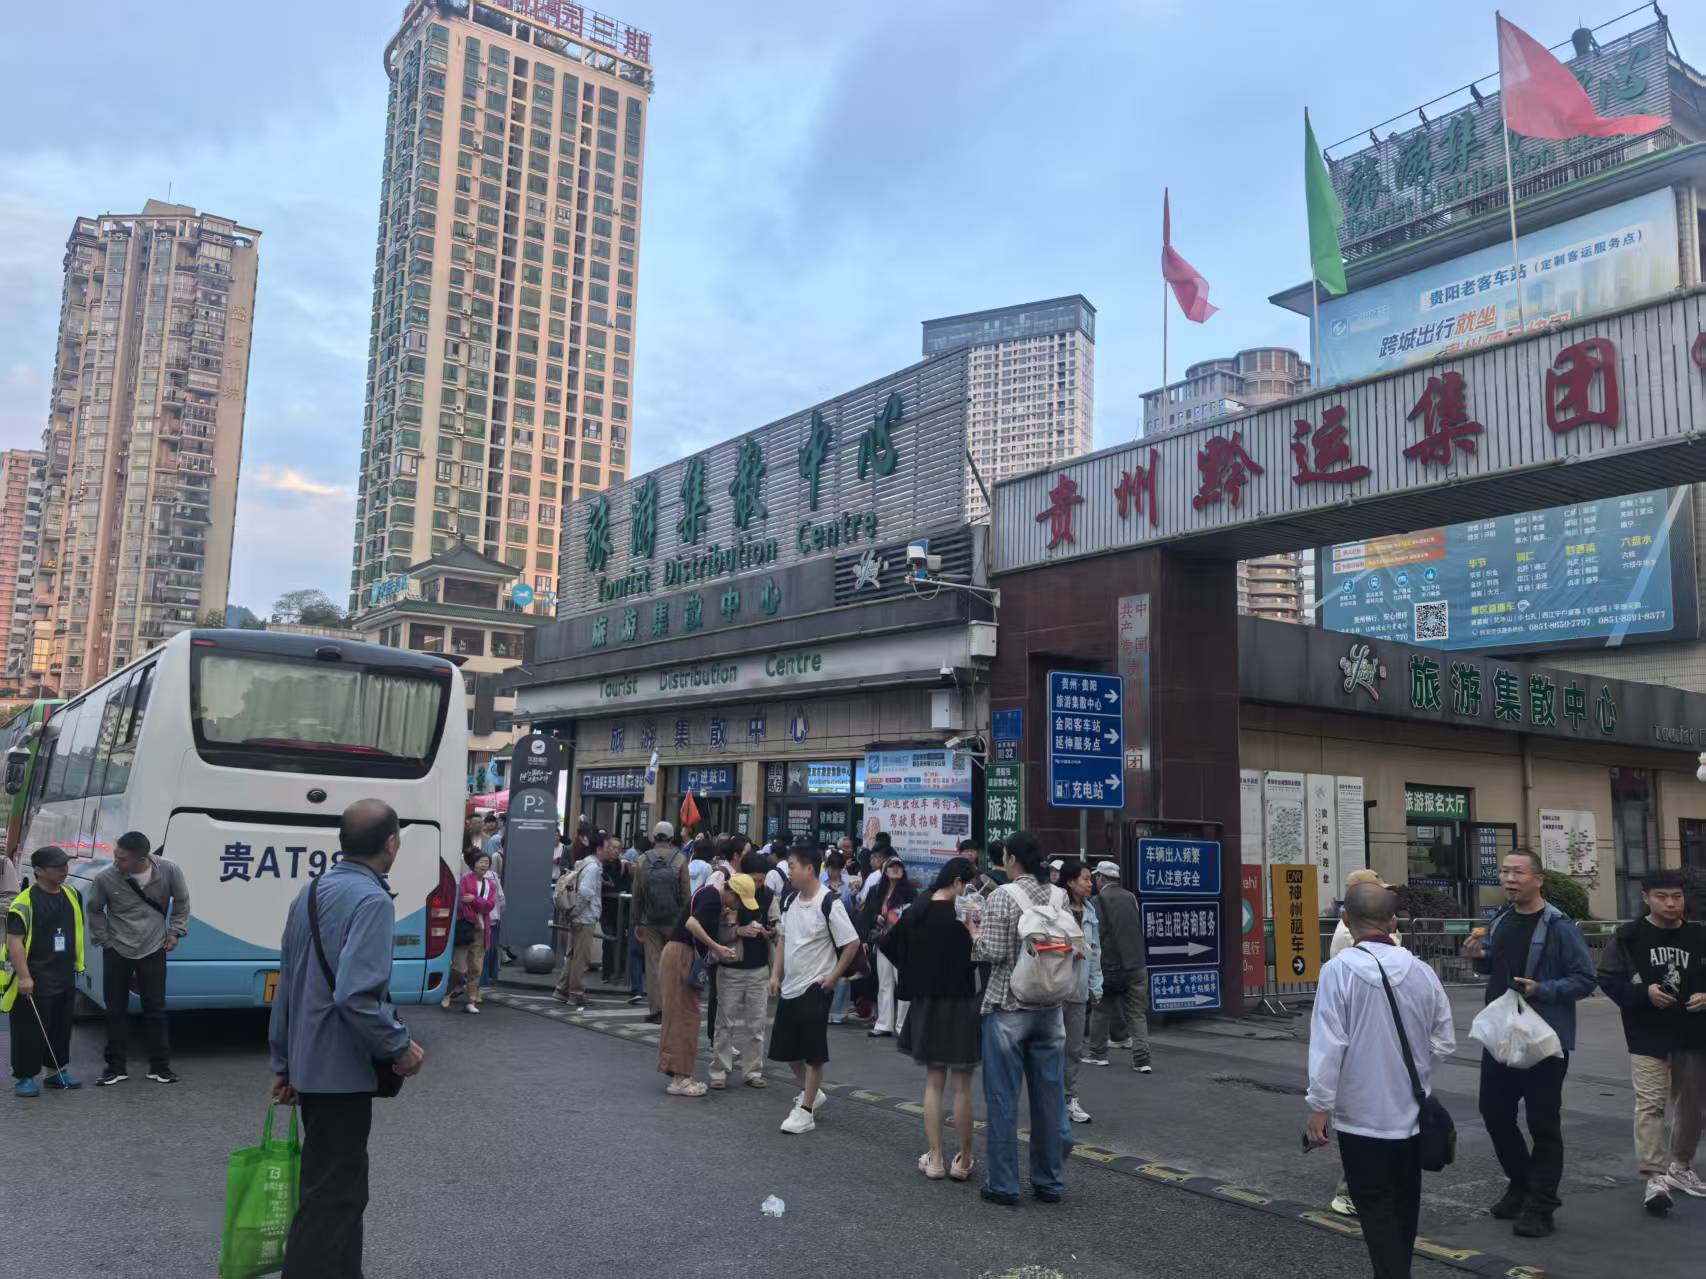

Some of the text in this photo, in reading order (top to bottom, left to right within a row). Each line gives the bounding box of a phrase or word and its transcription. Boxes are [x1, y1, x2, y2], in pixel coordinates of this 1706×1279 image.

[1429, 262, 1527, 308] 贵阳老客车站
[1378, 303, 1497, 359] 跨城出行就坐
[1035, 330, 1706, 549] 贵州黔运集团
[584, 391, 903, 572] 旅游集散中心
[598, 509, 878, 602] Tourist Distribution Centre
[592, 576, 782, 648] 旅游集散中心
[598, 652, 822, 700] Tourist Distribution Centre
[1408, 655, 1618, 736] 旅游集散中心
[1056, 694, 1102, 711] 旅游集散中心
[609, 703, 810, 753] 旅游集散中心
[1055, 716, 1101, 733] 金阳客车站
[1055, 735, 1101, 752] 延伸服务点
[988, 797, 1017, 822] 旅游
[1072, 780, 1103, 800] 充电站
[1405, 790, 1465, 814] 旅游报名大厅
[219, 842, 345, 882] 贵AT9
[1146, 847, 1201, 864] 车辆出入频繁
[1146, 869, 1201, 888] 行人注意安全
[1147, 910, 1216, 938] 黔运出租咨询服务
[1289, 885, 1305, 953] 神州租车
